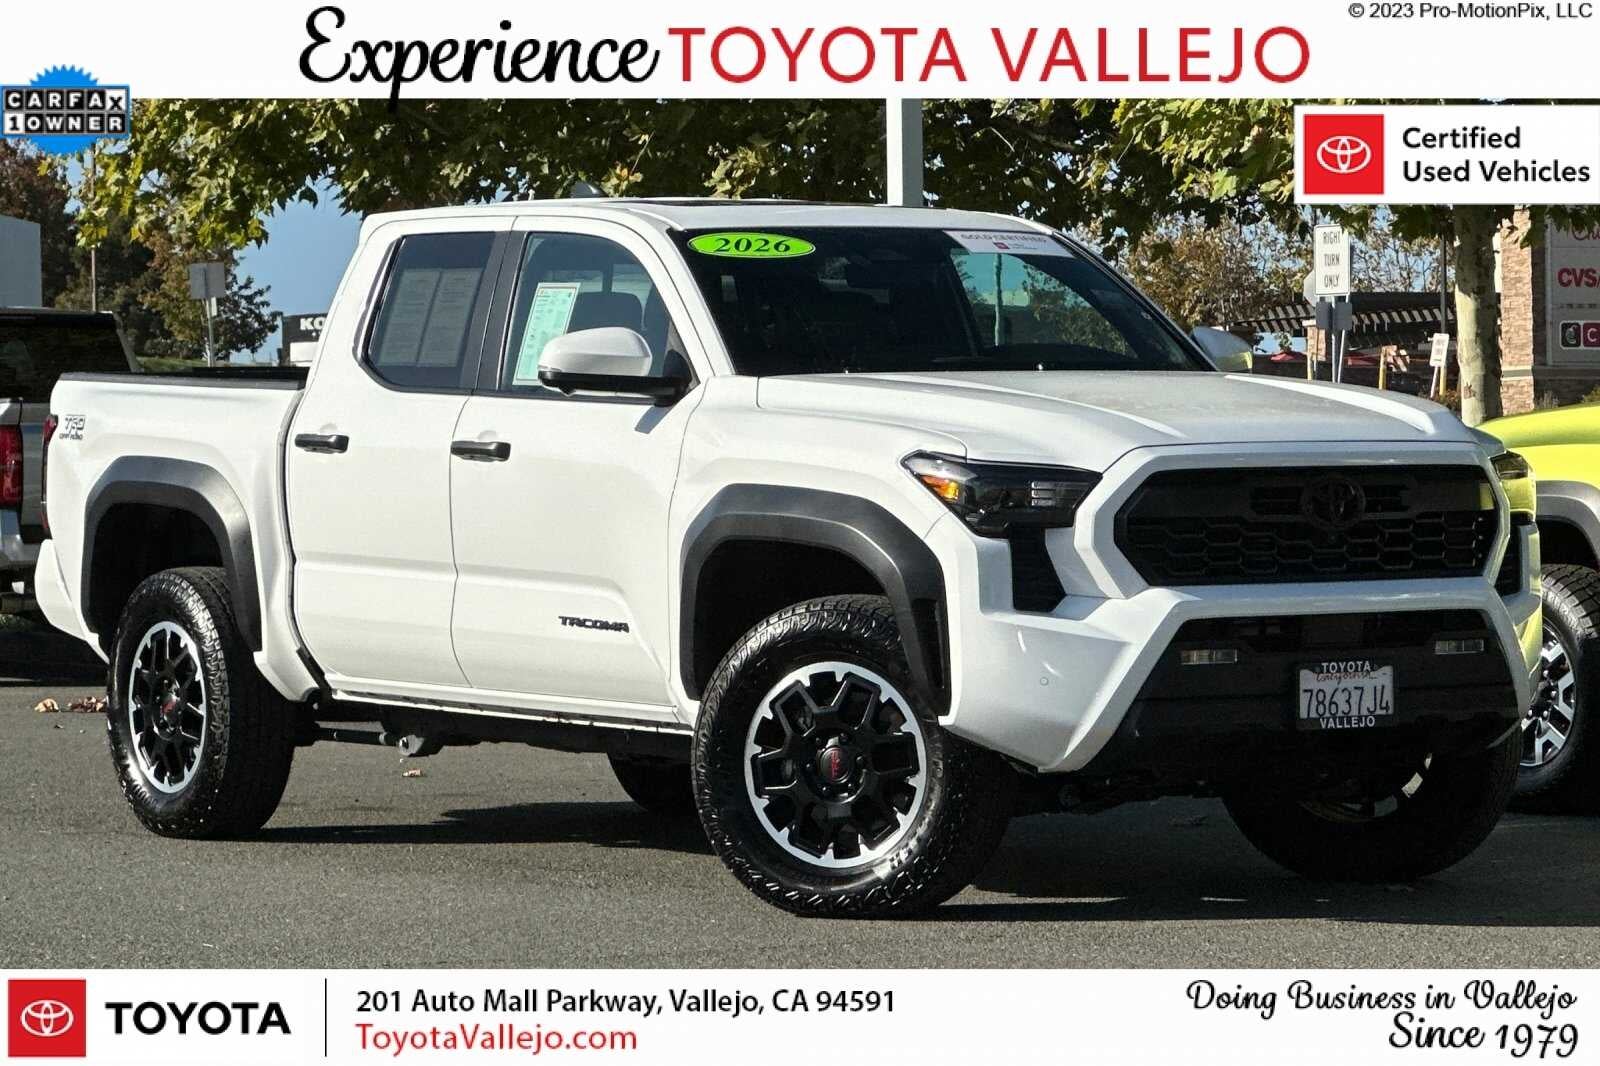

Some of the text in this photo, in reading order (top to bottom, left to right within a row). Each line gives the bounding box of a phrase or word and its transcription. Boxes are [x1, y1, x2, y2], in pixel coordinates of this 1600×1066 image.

[1323, 231, 1341, 244] RIGHT
[714, 238, 791, 252] 2026
[1324, 253, 1340, 267] TURN
[1323, 274, 1340, 288] ONLY
[558, 615, 629, 633] TACOMA
[1321, 661, 1371, 674] TOYOTA
[1302, 685, 1391, 718] 78637J4
[1319, 715, 1376, 729] VALLEJO
